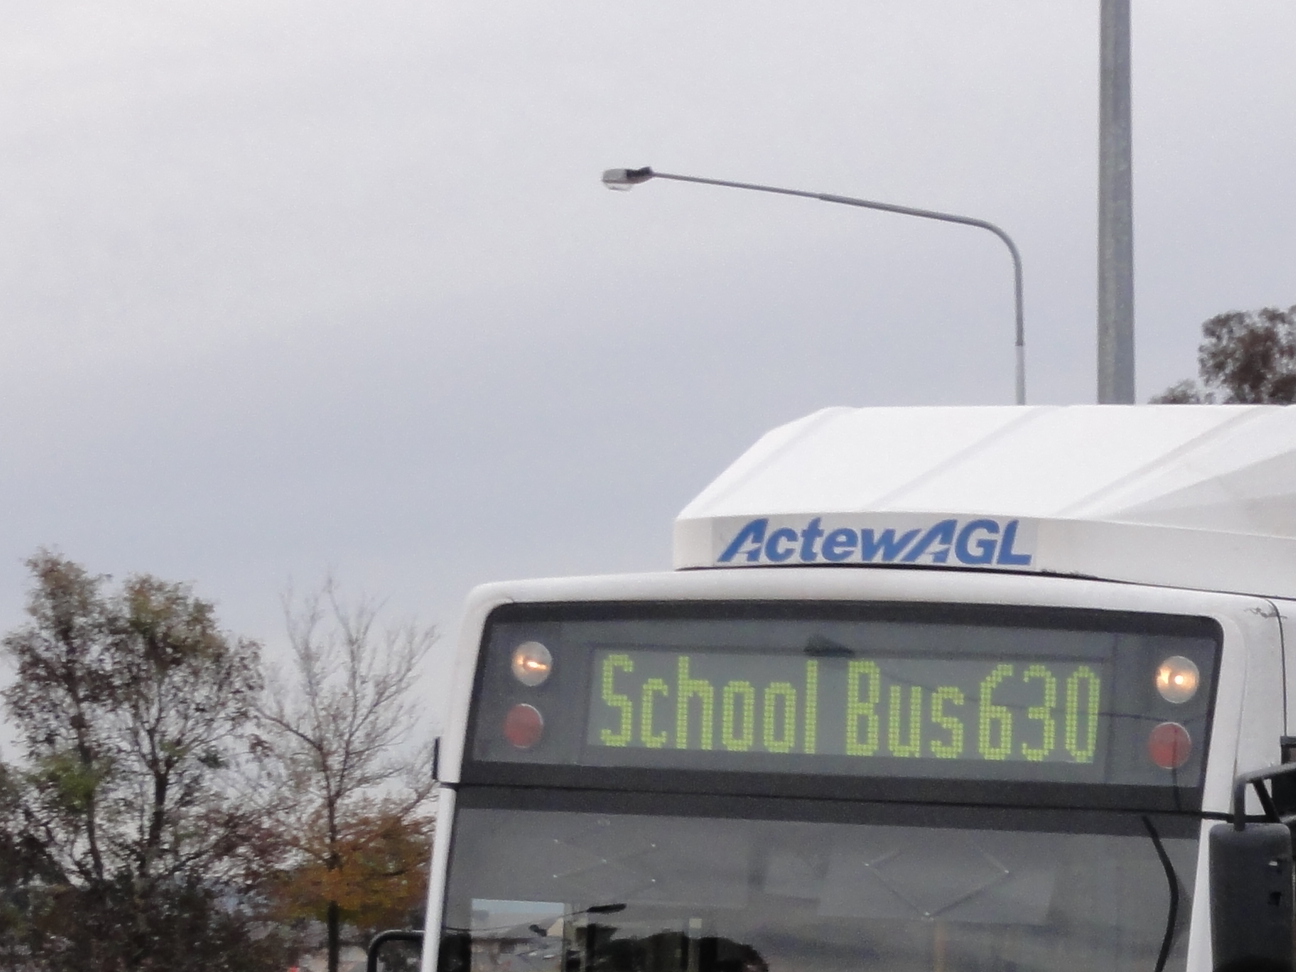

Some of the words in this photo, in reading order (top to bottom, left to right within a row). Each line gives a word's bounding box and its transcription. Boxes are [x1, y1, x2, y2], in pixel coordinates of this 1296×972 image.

[717, 517, 1031, 566] ActewAGL
[600, 654, 818, 754] School
[847, 660, 963, 760] Bus
[979, 664, 1100, 763] 630
